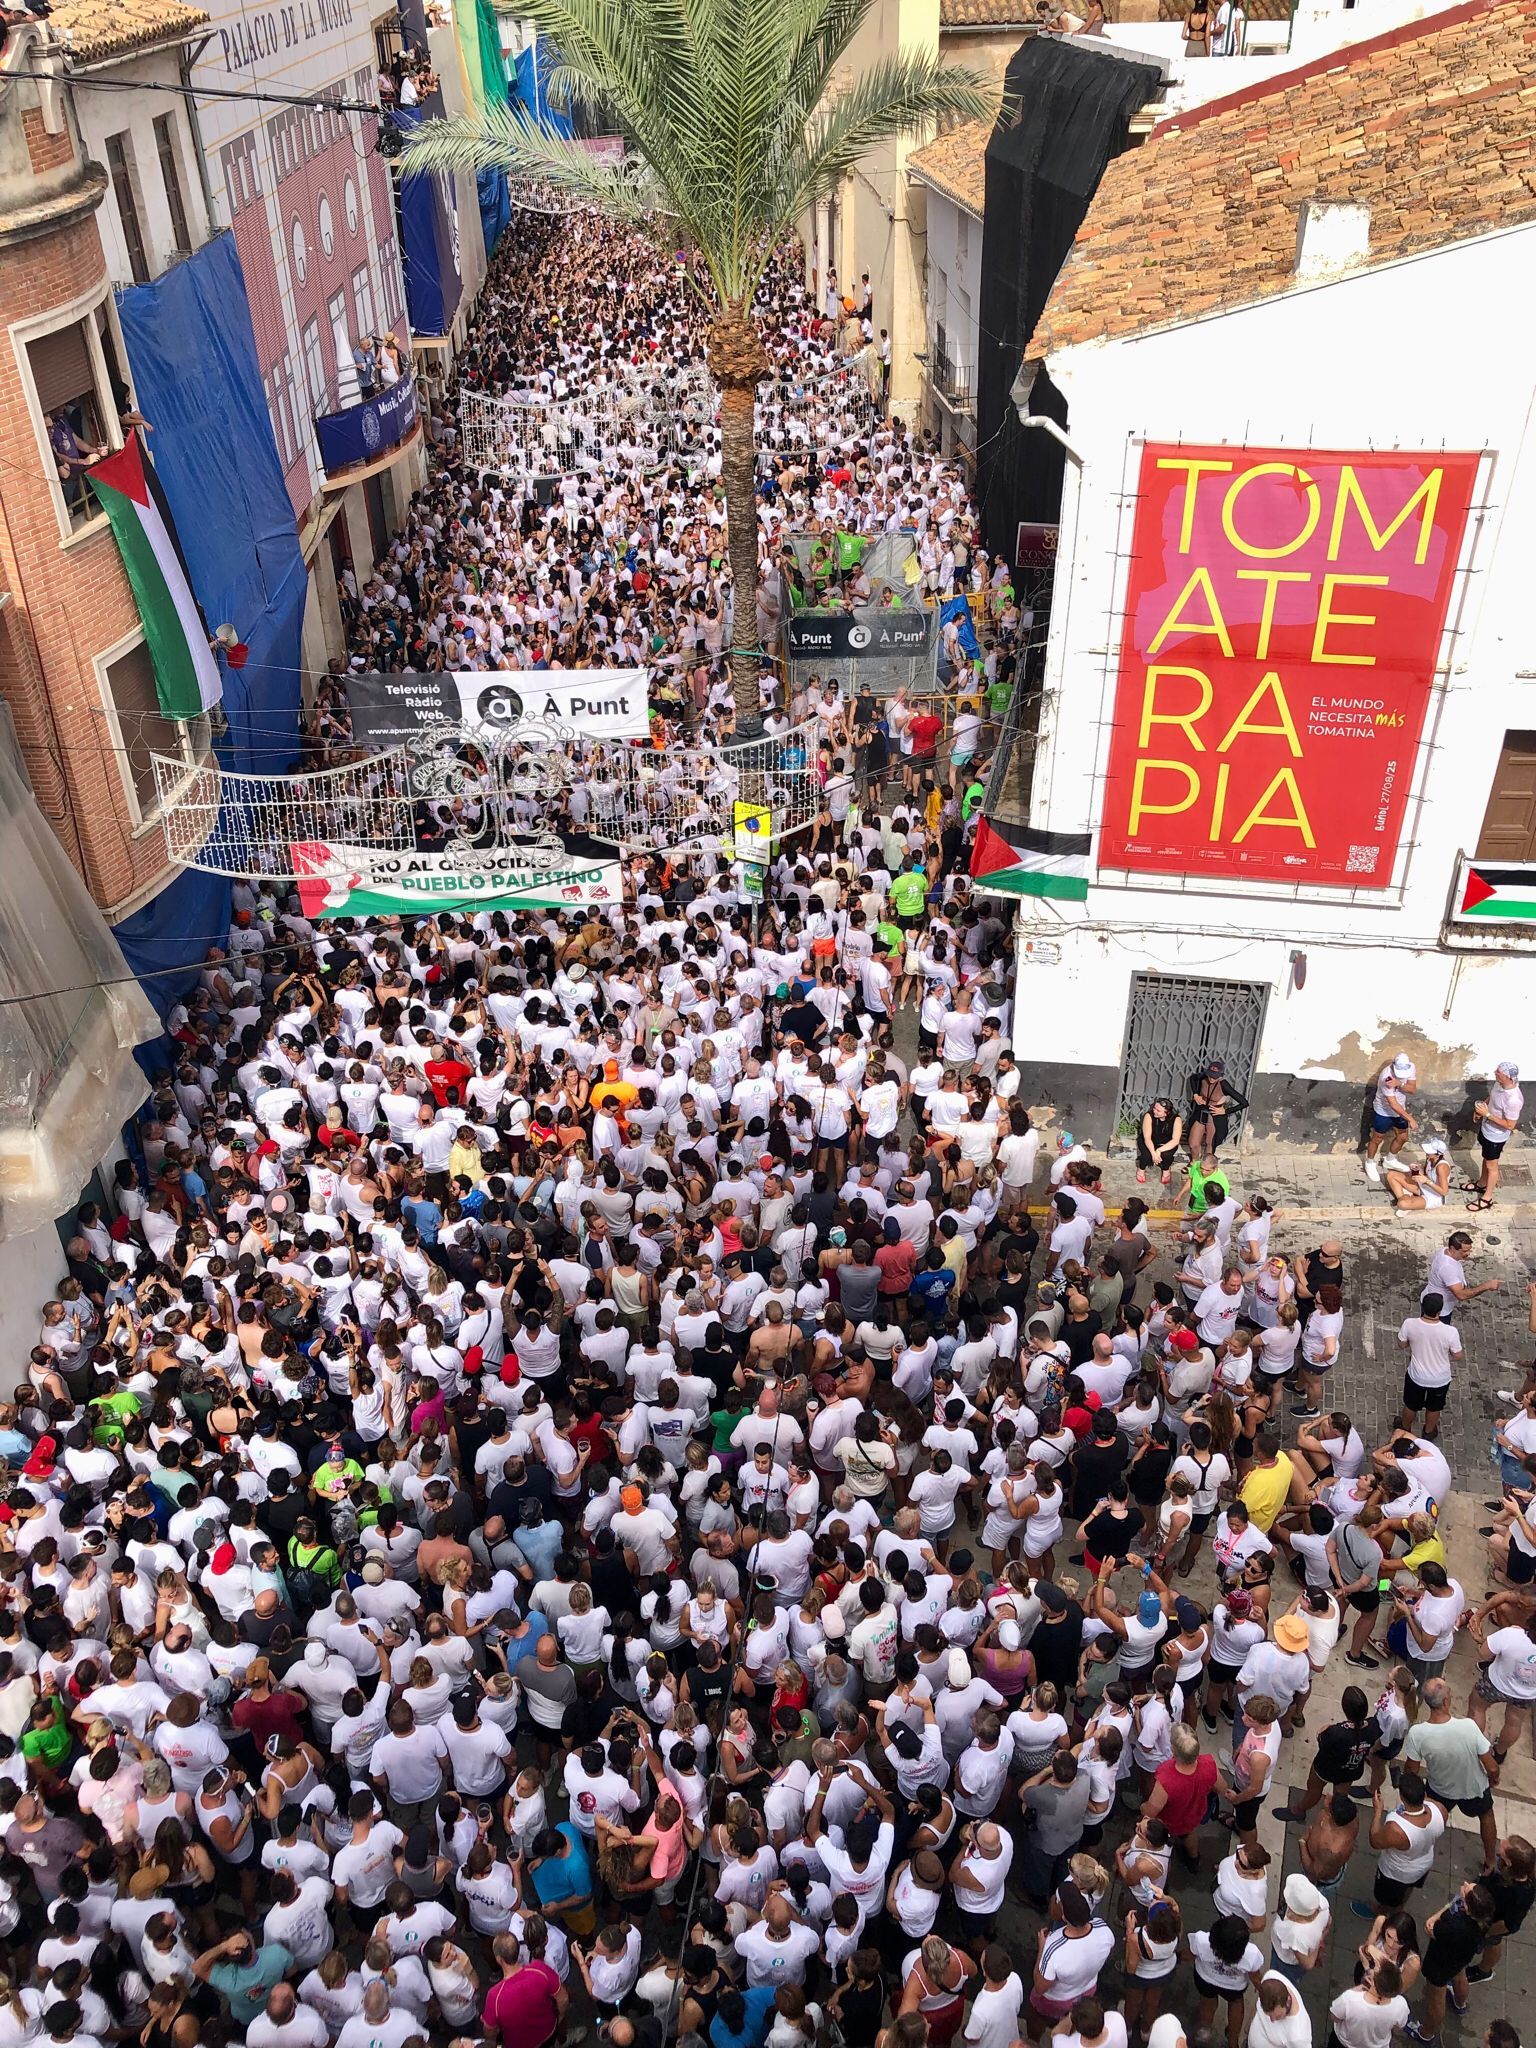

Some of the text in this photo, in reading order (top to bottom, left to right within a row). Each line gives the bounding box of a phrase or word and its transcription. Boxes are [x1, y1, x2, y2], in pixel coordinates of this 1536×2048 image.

[219, 12, 278, 73] PALACIO
[280, 6, 299, 49] DE
[300, 1, 317, 40] LA
[1156, 458, 1444, 564] TOM
[1148, 568, 1388, 665] ATE
[790, 630, 798, 645] À
[801, 633, 832, 645] Punt
[880, 629, 891, 643] À
[385, 684, 440, 695] Televisió
[405, 697, 443, 708] Ràdio
[543, 692, 562, 717] À
[570, 697, 630, 717] Punt
[1138, 665, 1303, 757] RA
[1311, 696, 1385, 710] EL MUNDO
[414, 710, 444, 720] Web
[1309, 709, 1406, 728] NECESITA MÁS
[1307, 725, 1375, 738] TOMATINA
[1380, 760, 1397, 804] 27/08/25
[1128, 759, 1316, 849] PIA
[369, 858, 401, 873] NO
[408, 860, 434, 872] AL
[372, 869, 603, 891] DEL PUEBLO PALESTINO
